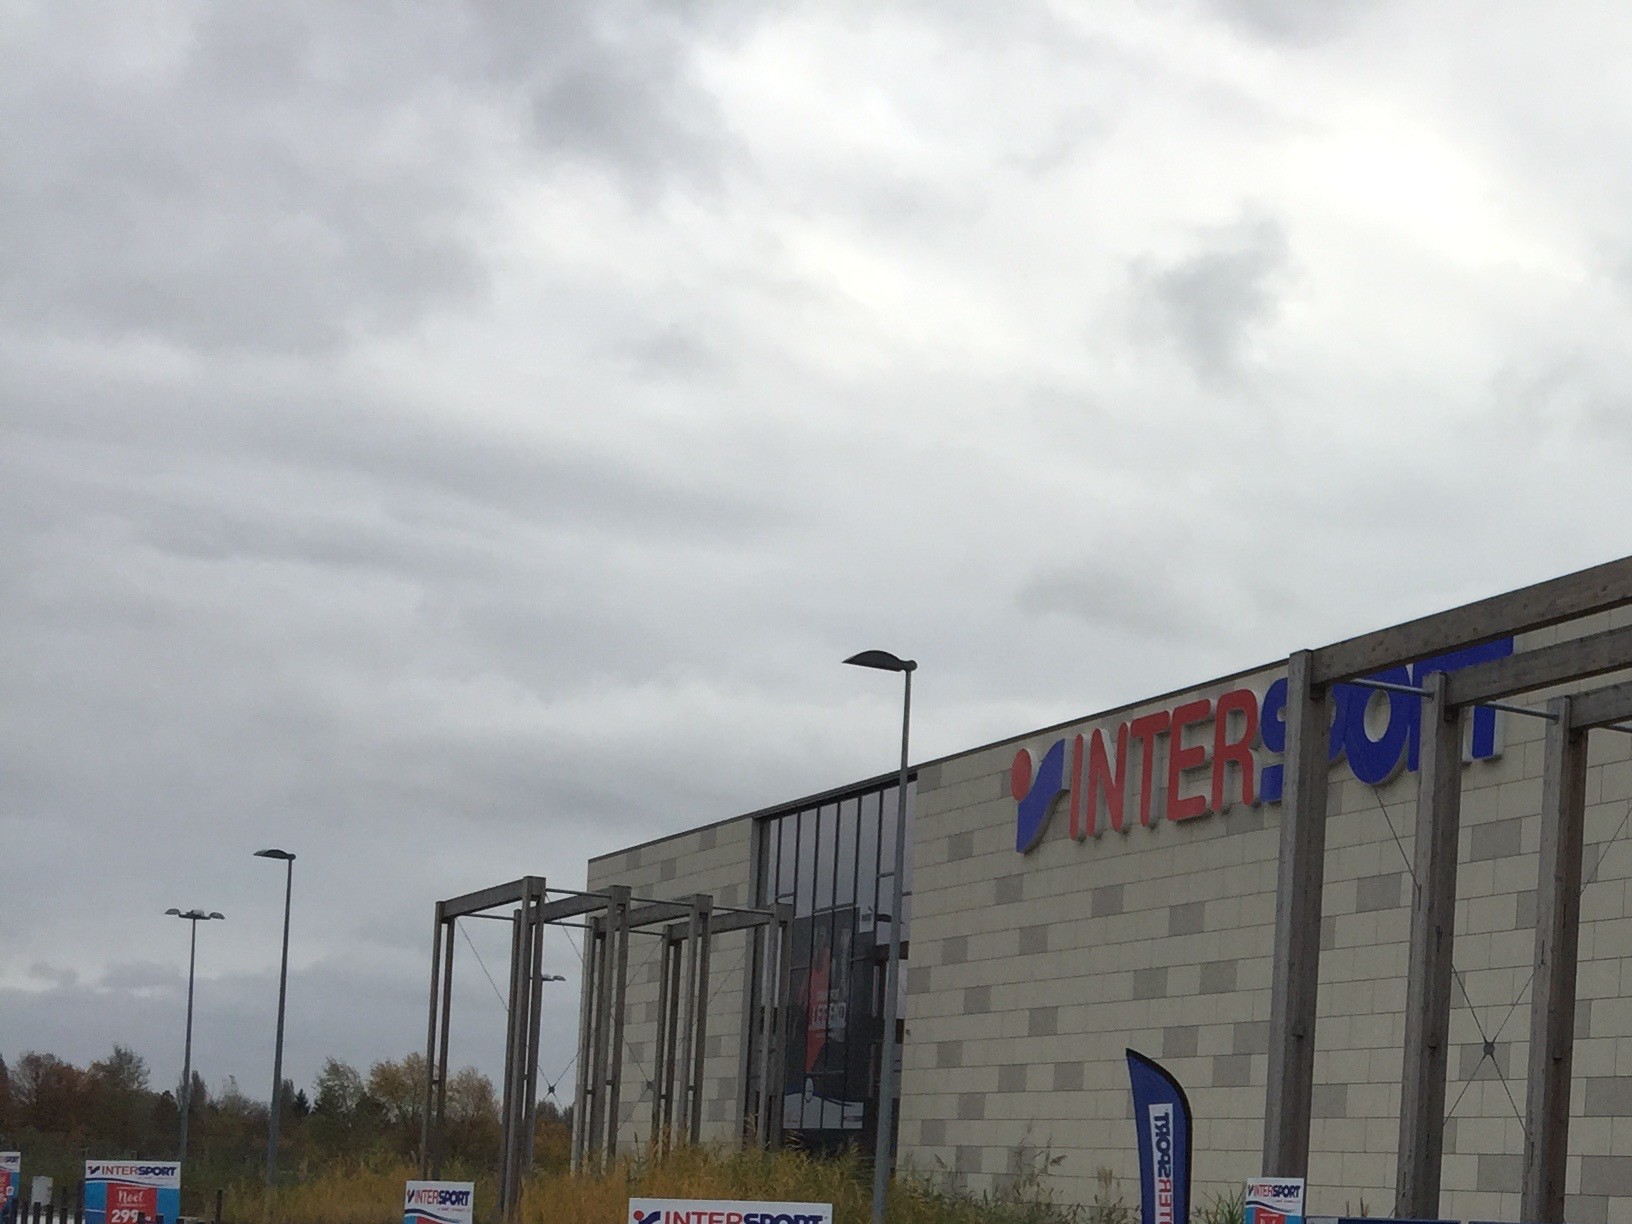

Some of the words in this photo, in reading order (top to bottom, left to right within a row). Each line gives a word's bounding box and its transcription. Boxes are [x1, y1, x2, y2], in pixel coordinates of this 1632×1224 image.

[102, 1165, 177, 1176] INTERSPORT
[415, 1189, 471, 1206] INTERSPORT
[1254, 1184, 1301, 1198] INTERSPORT
